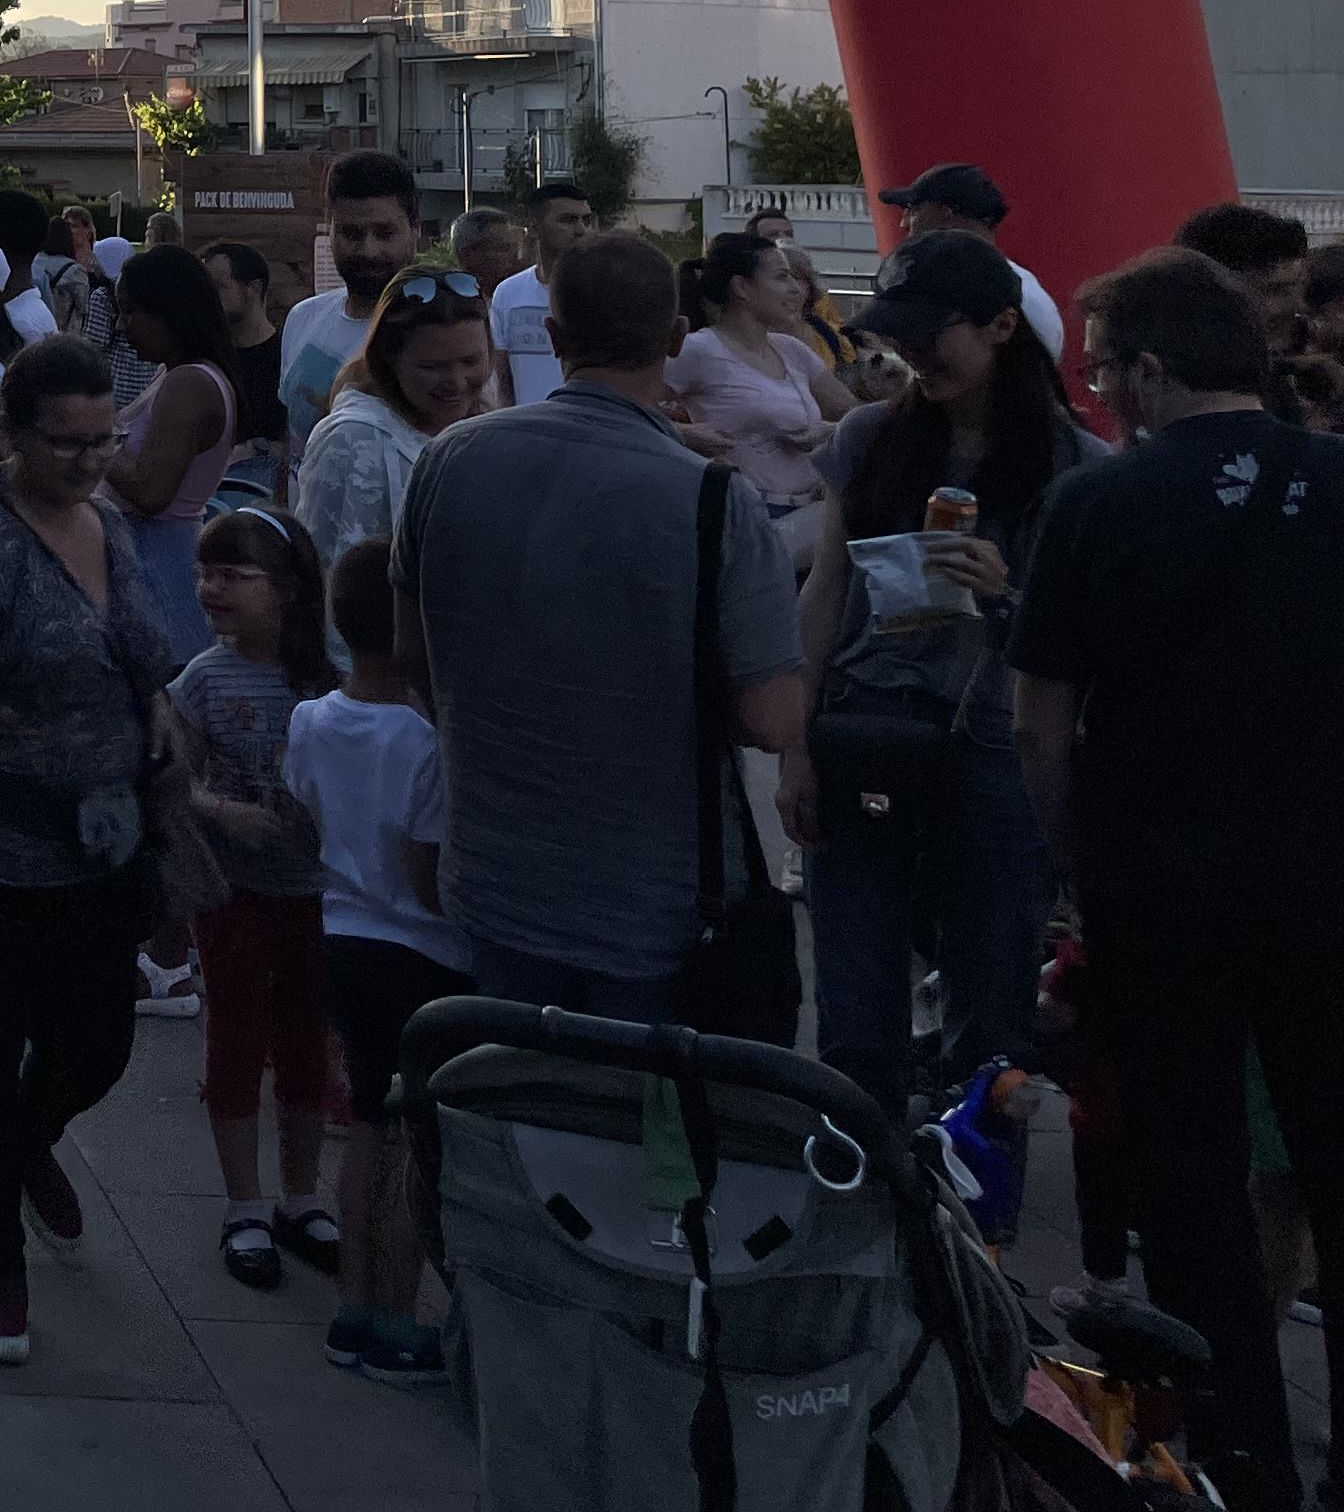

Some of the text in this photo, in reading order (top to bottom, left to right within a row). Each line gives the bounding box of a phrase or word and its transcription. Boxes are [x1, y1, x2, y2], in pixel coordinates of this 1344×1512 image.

[194, 191, 295, 209] PACK DE BENVINGUDA
